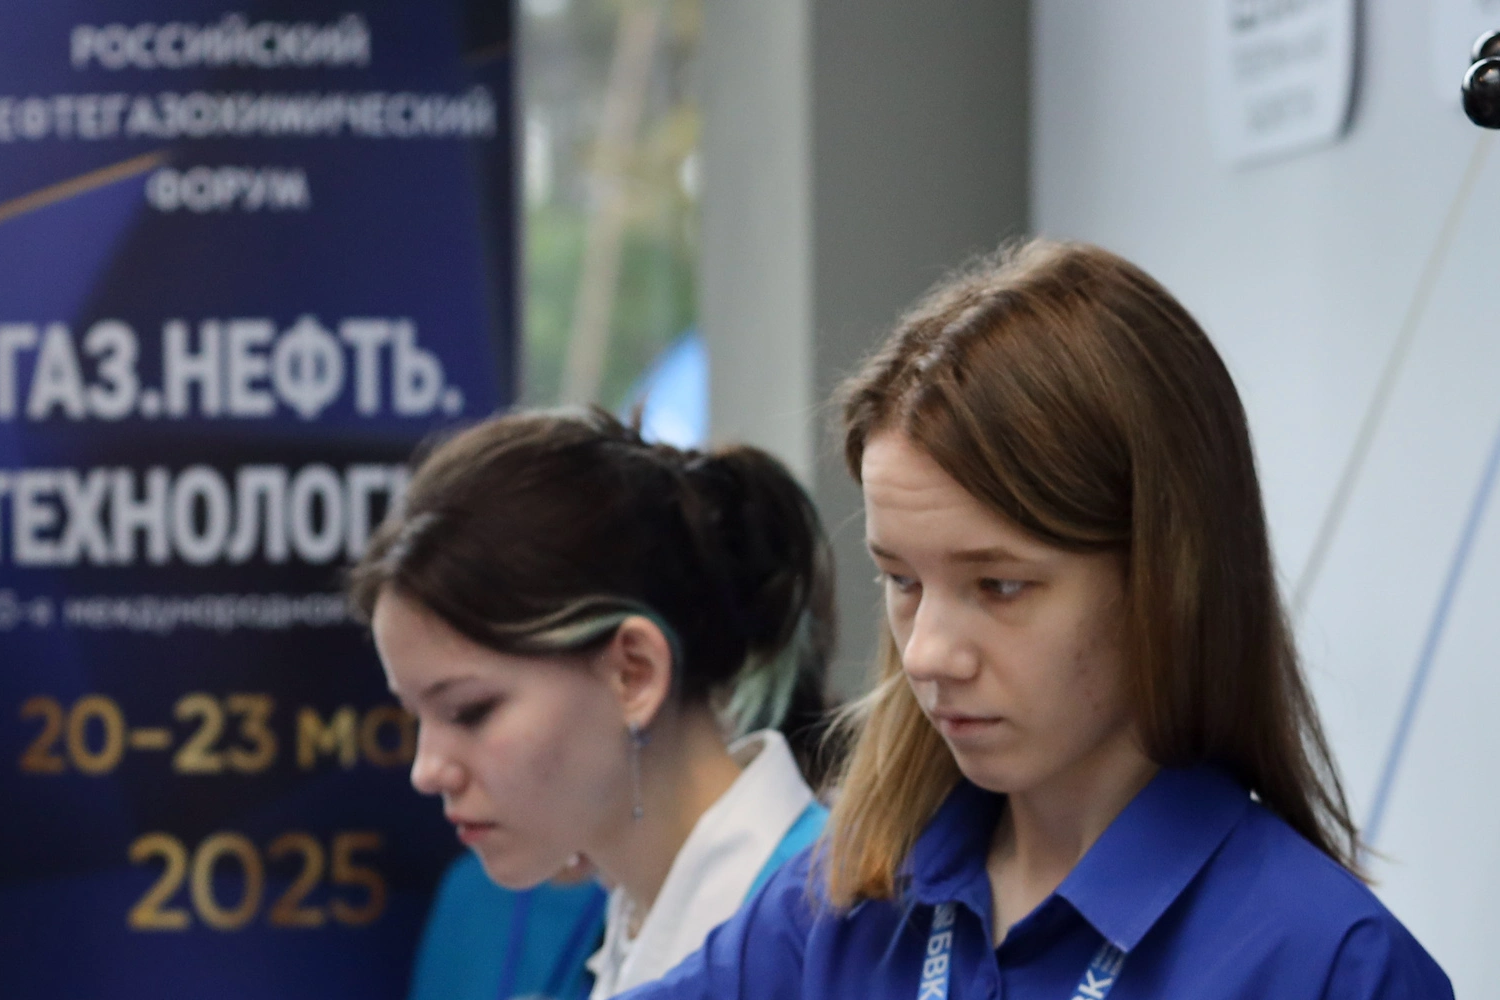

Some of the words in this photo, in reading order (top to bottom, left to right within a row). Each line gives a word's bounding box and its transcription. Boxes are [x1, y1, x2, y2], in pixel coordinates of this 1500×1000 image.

[72, 12, 369, 69] РОССИЙСКИЙ
[147, 166, 311, 211] ФОРУМ
[127, 833, 387, 930] 2025
